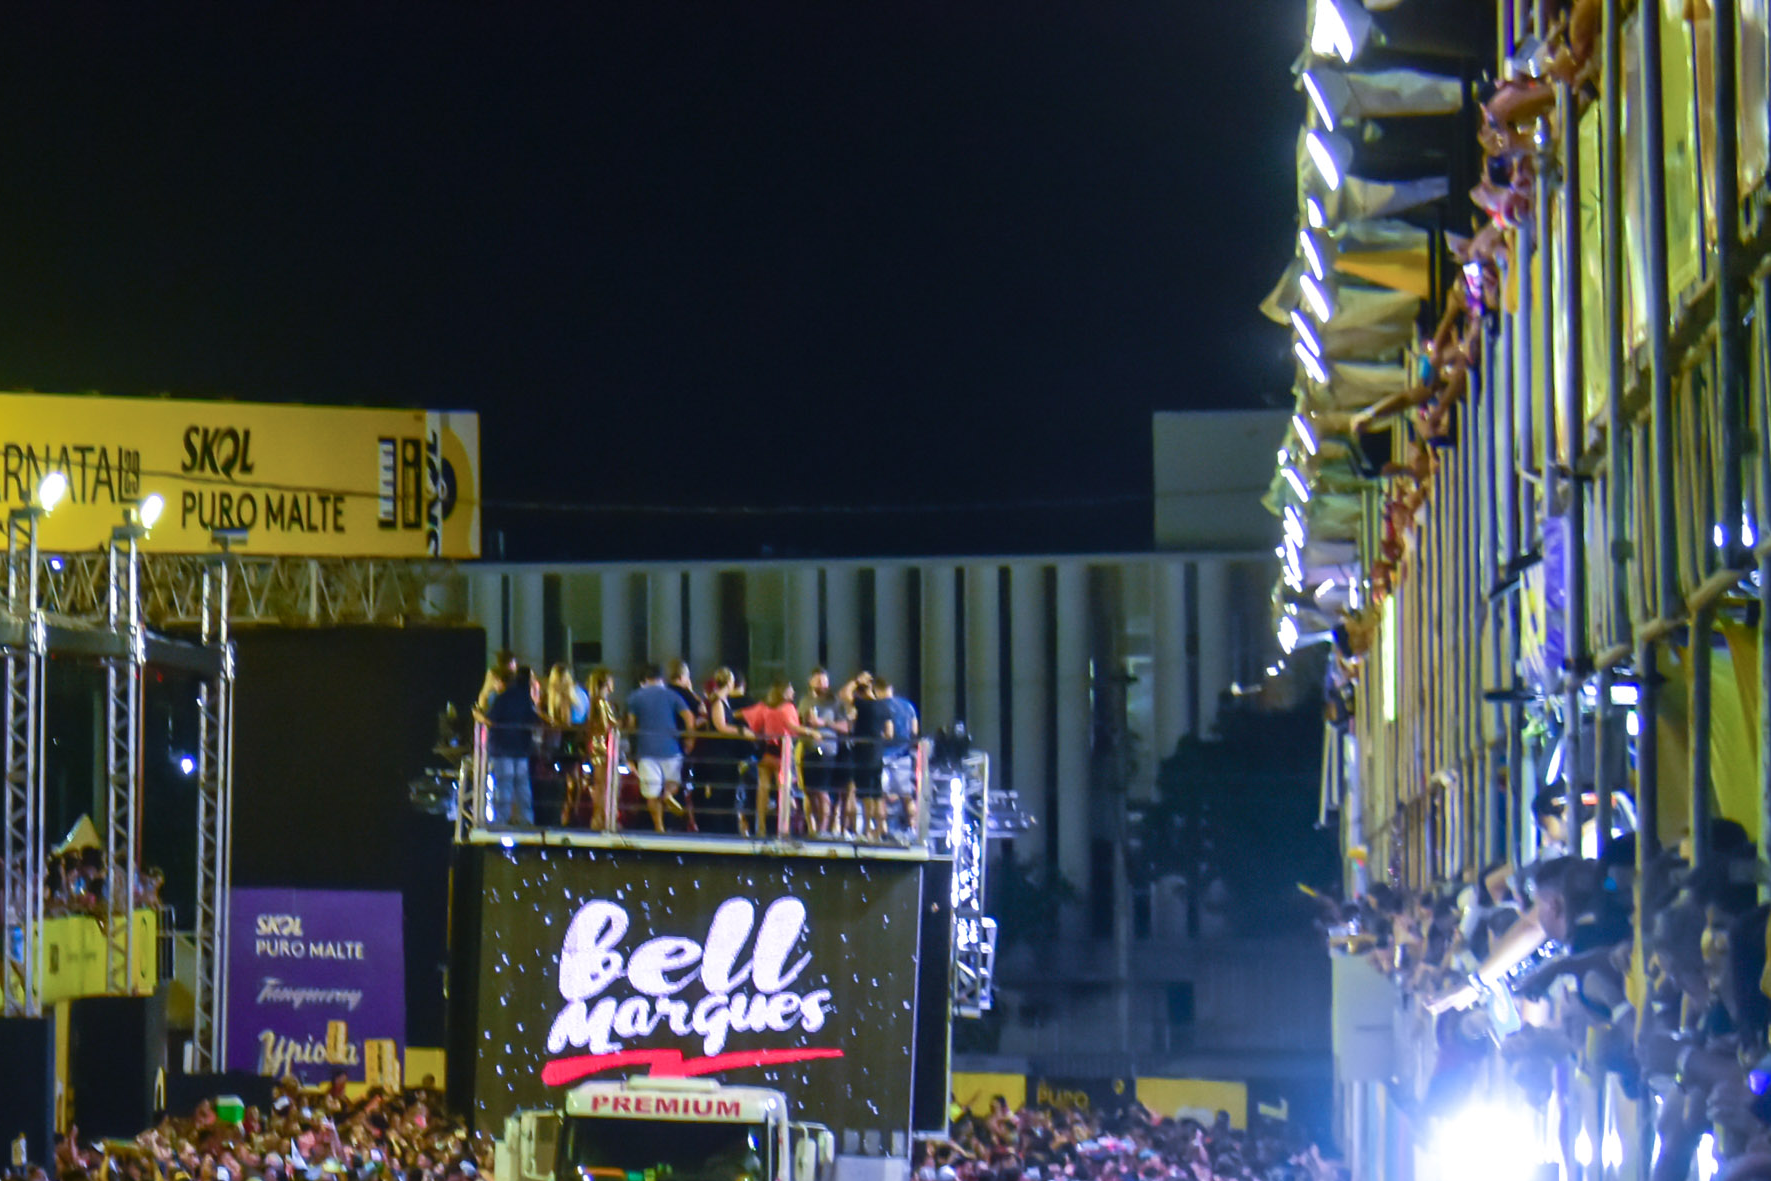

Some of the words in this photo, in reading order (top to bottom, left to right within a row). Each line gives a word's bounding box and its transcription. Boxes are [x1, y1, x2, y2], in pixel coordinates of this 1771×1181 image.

[181, 424, 255, 480] SKOL
[181, 489, 257, 531] PURO
[264, 493, 346, 534] MALTE
[254, 913, 304, 938] SKOL
[255, 938, 305, 959] PURO
[308, 941, 365, 961] MALTE
[546, 988, 833, 1057] Marques
[590, 1095, 742, 1118] PREMIUM
